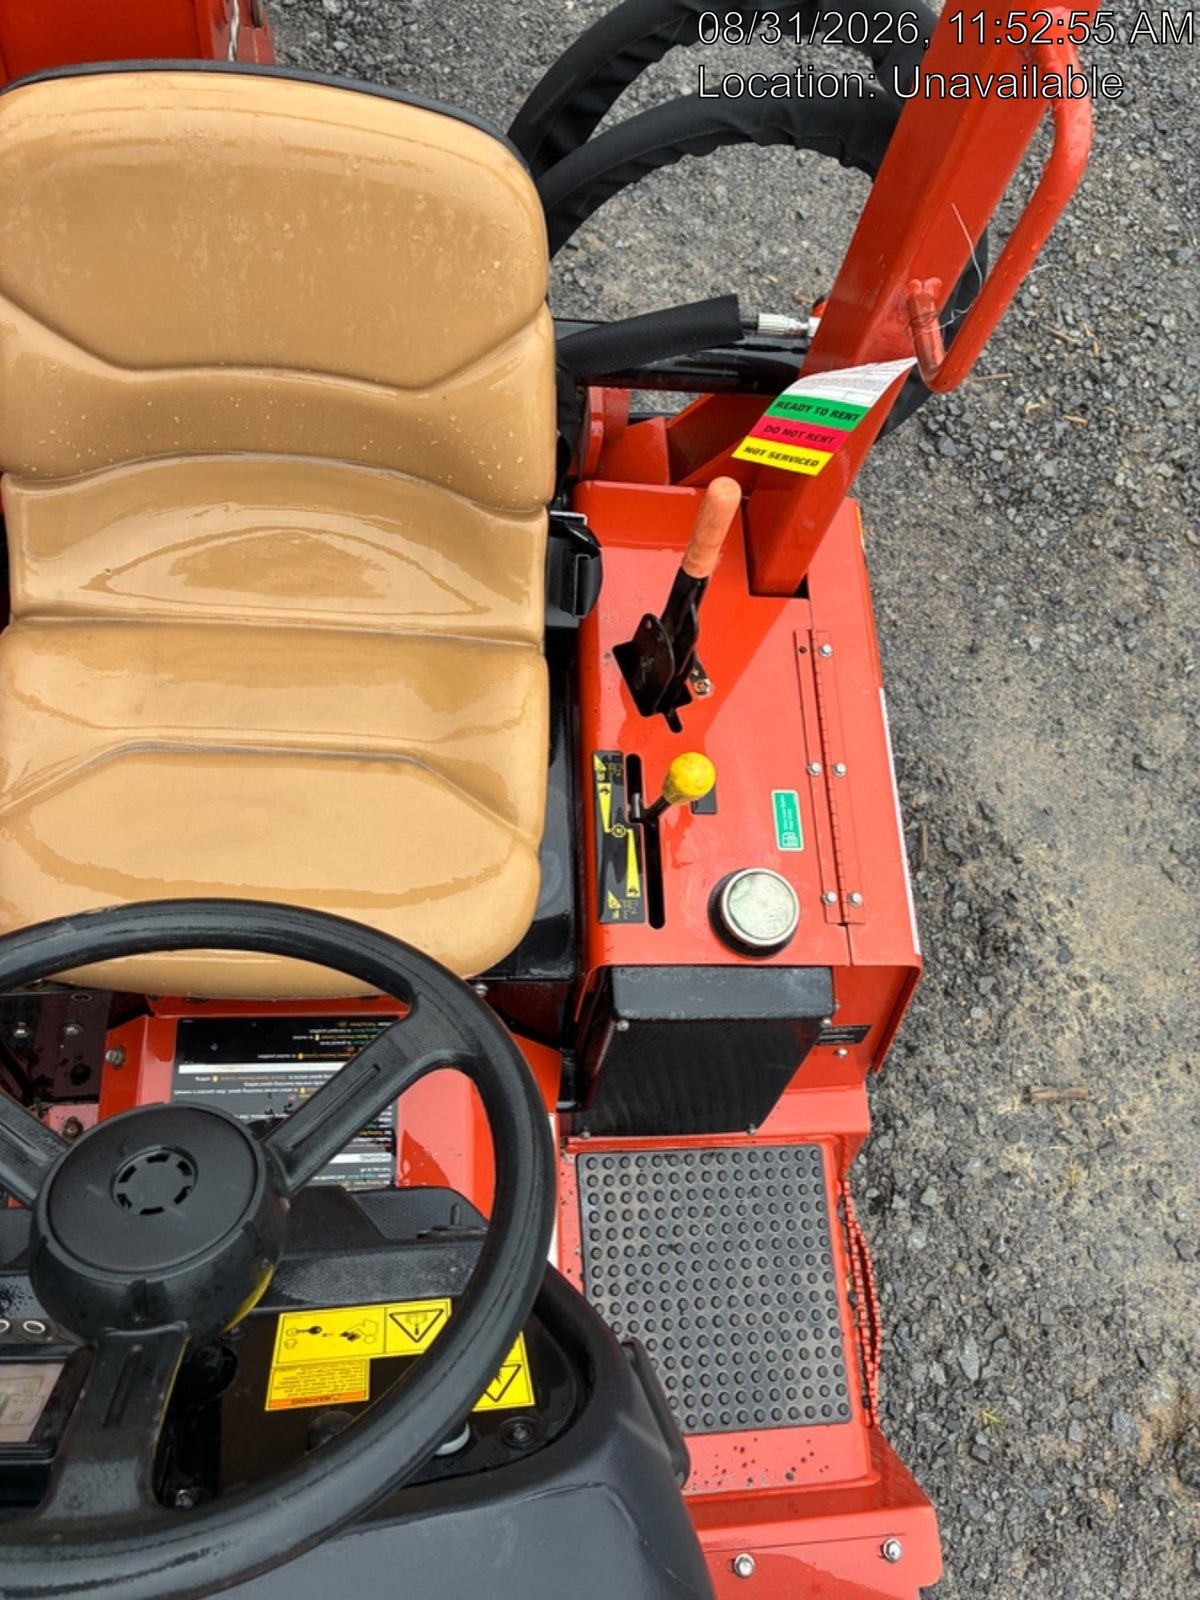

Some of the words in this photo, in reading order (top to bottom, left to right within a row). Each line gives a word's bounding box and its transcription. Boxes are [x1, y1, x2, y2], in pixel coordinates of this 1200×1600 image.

[775, 401, 812, 414] READY
[814, 406, 829, 417] TO
[830, 410, 860, 422] RENT
[763, 424, 781, 434] DO
[782, 427, 806, 439] NOT
[805, 432, 837, 444] RENT
[743, 446, 768, 457] NOT
[768, 450, 820, 468] SERVICED
